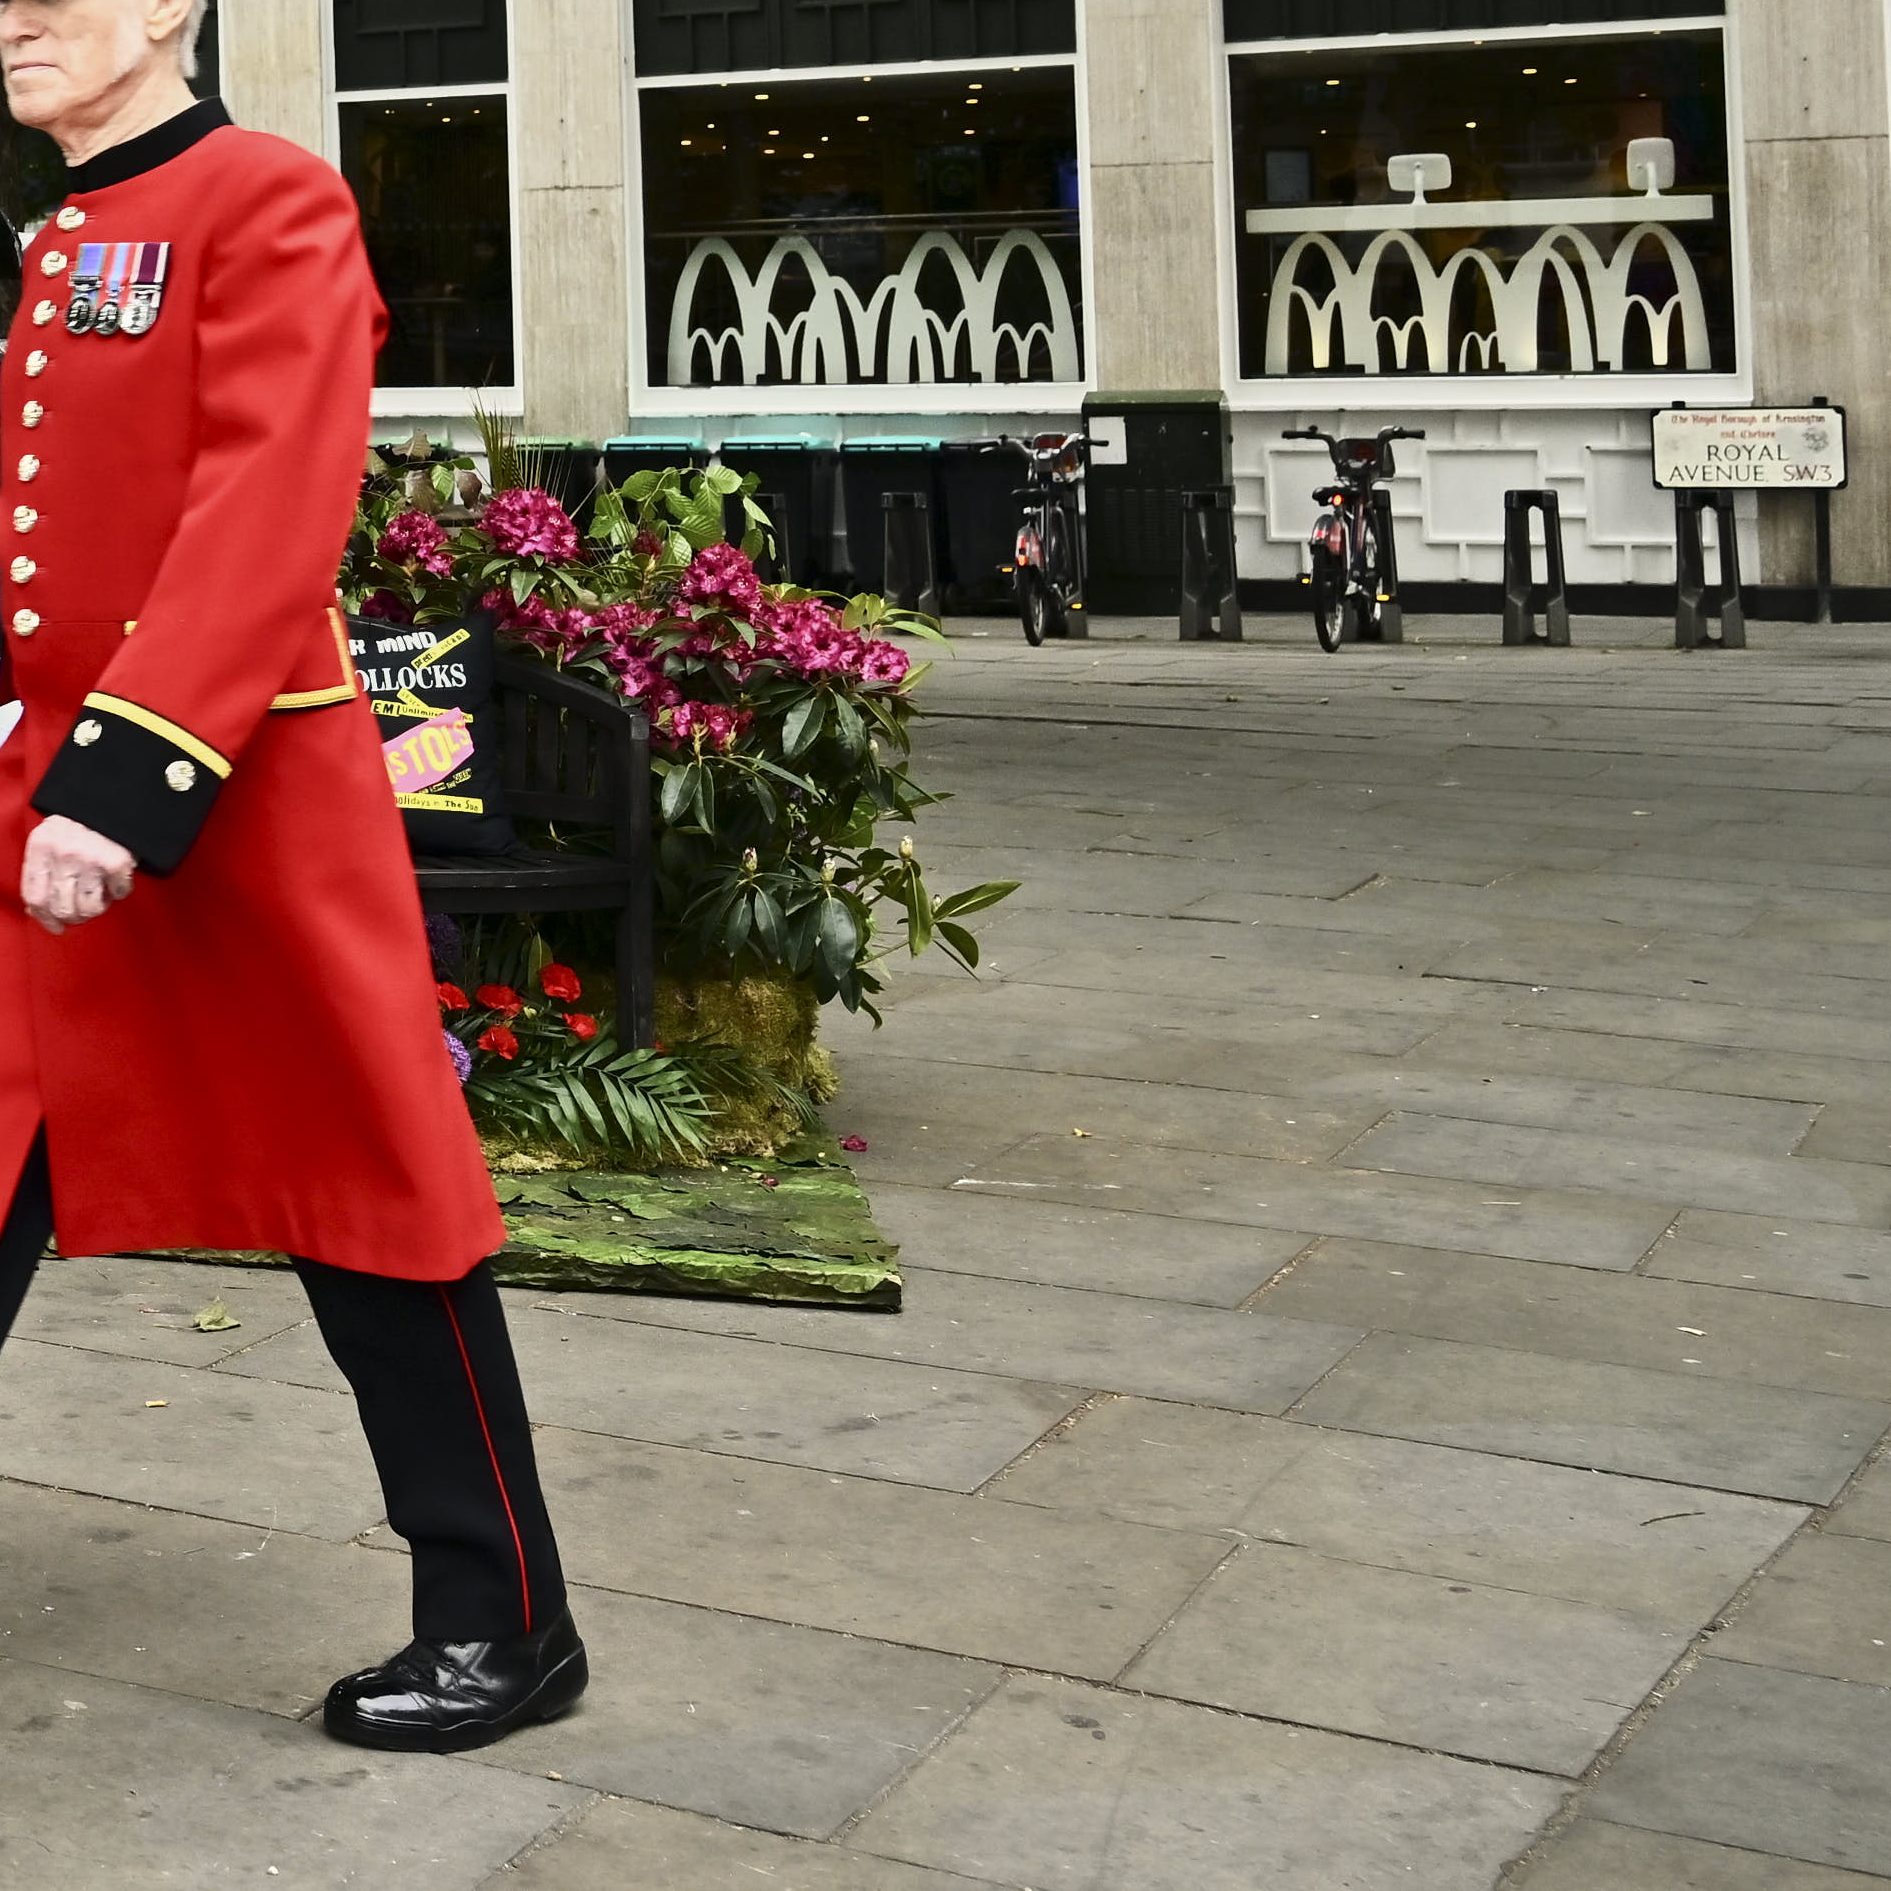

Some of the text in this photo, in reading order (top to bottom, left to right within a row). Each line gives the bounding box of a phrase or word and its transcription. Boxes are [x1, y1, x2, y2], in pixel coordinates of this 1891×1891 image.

[1691, 414, 1717, 426] Royal
[1721, 414, 1757, 426] Borough
[1762, 414, 1770, 423] of
[1775, 414, 1826, 425] Kensington
[1706, 444, 1790, 462] ROYAL
[355, 663, 467, 692] OLLOCKS
[402, 707, 444, 717] Unlimite
[385, 720, 471, 784] ISTOLS
[397, 795, 430, 807] olidays
[444, 800, 462, 808] The
